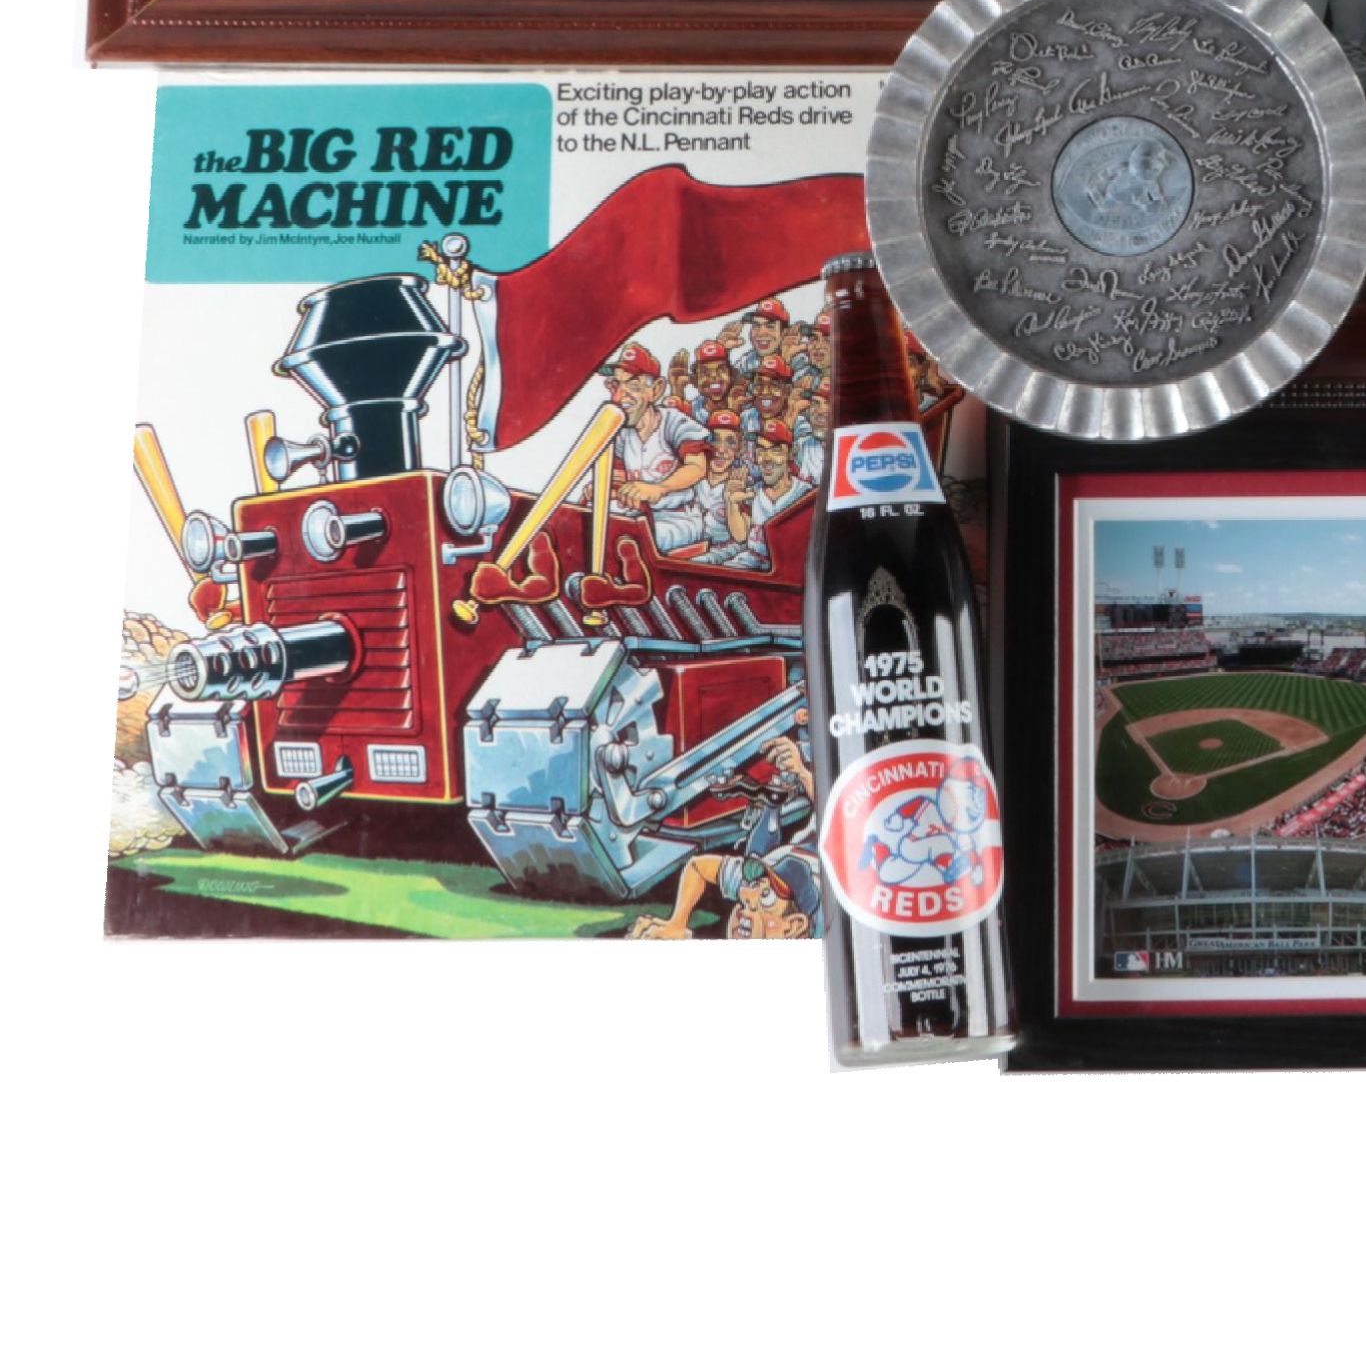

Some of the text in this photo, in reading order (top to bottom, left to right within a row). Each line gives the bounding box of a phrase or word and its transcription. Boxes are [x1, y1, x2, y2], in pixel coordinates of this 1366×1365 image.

[557, 81, 851, 105] Exciting play-by-play action
[557, 106, 853, 126] of the Cincinnati Reds drive
[240, 127, 357, 173] BIG
[371, 126, 513, 172] RED
[557, 133, 751, 152] to the N.L. Pennant
[183, 180, 504, 229] MACHINE
[183, 234, 235, 245] Narrated
[239, 234, 254, 246] by
[256, 234, 277, 245] Jim
[357, 233, 401, 244] Nuxhall
[851, 452, 917, 474] PEPSI
[863, 652, 924, 678] 1975
[850, 676, 945, 706] WORLD
[829, 701, 973, 737] CHAMPIONS
[843, 760, 945, 818] CINCINNATI
[870, 885, 967, 916] REDS
